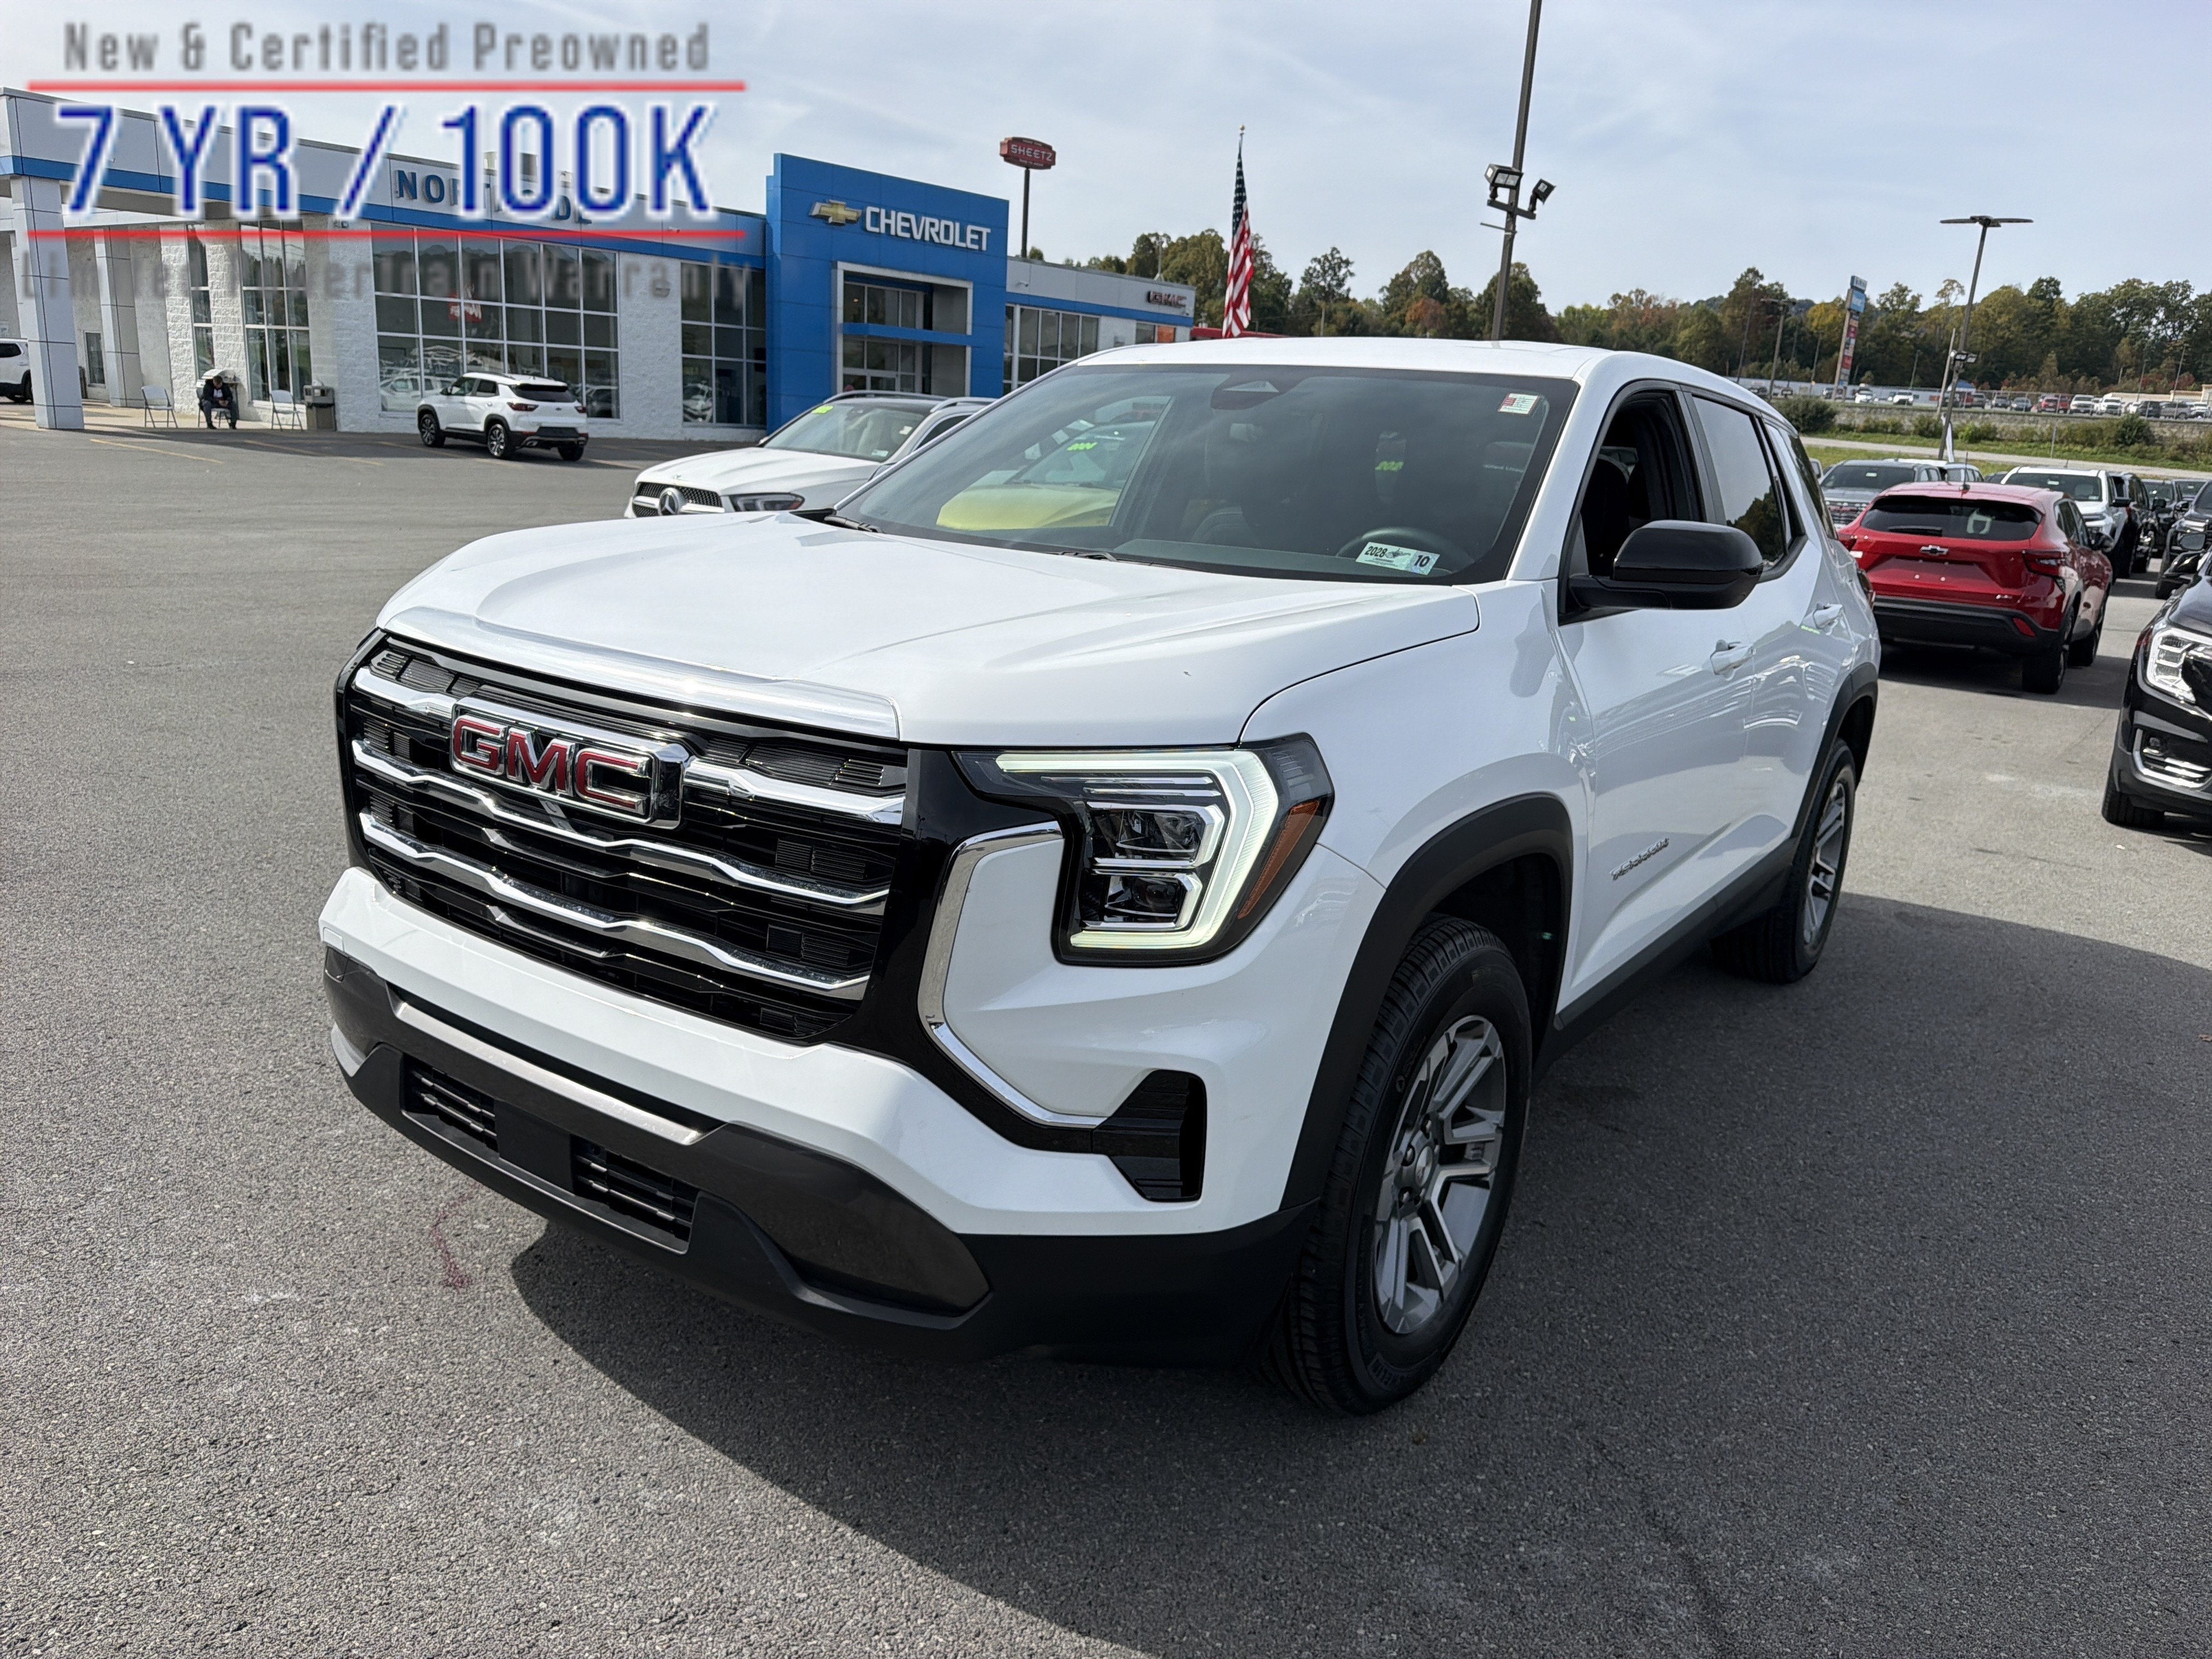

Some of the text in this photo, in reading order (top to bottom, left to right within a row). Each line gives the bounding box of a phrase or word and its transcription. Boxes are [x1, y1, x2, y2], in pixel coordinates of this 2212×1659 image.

[1011, 144, 1053, 162] SHEETZ
[865, 206, 991, 251] CHEVROLET
[1364, 546, 1388, 558] 2028
[1413, 555, 1430, 567] 10
[453, 714, 651, 816] GMC
